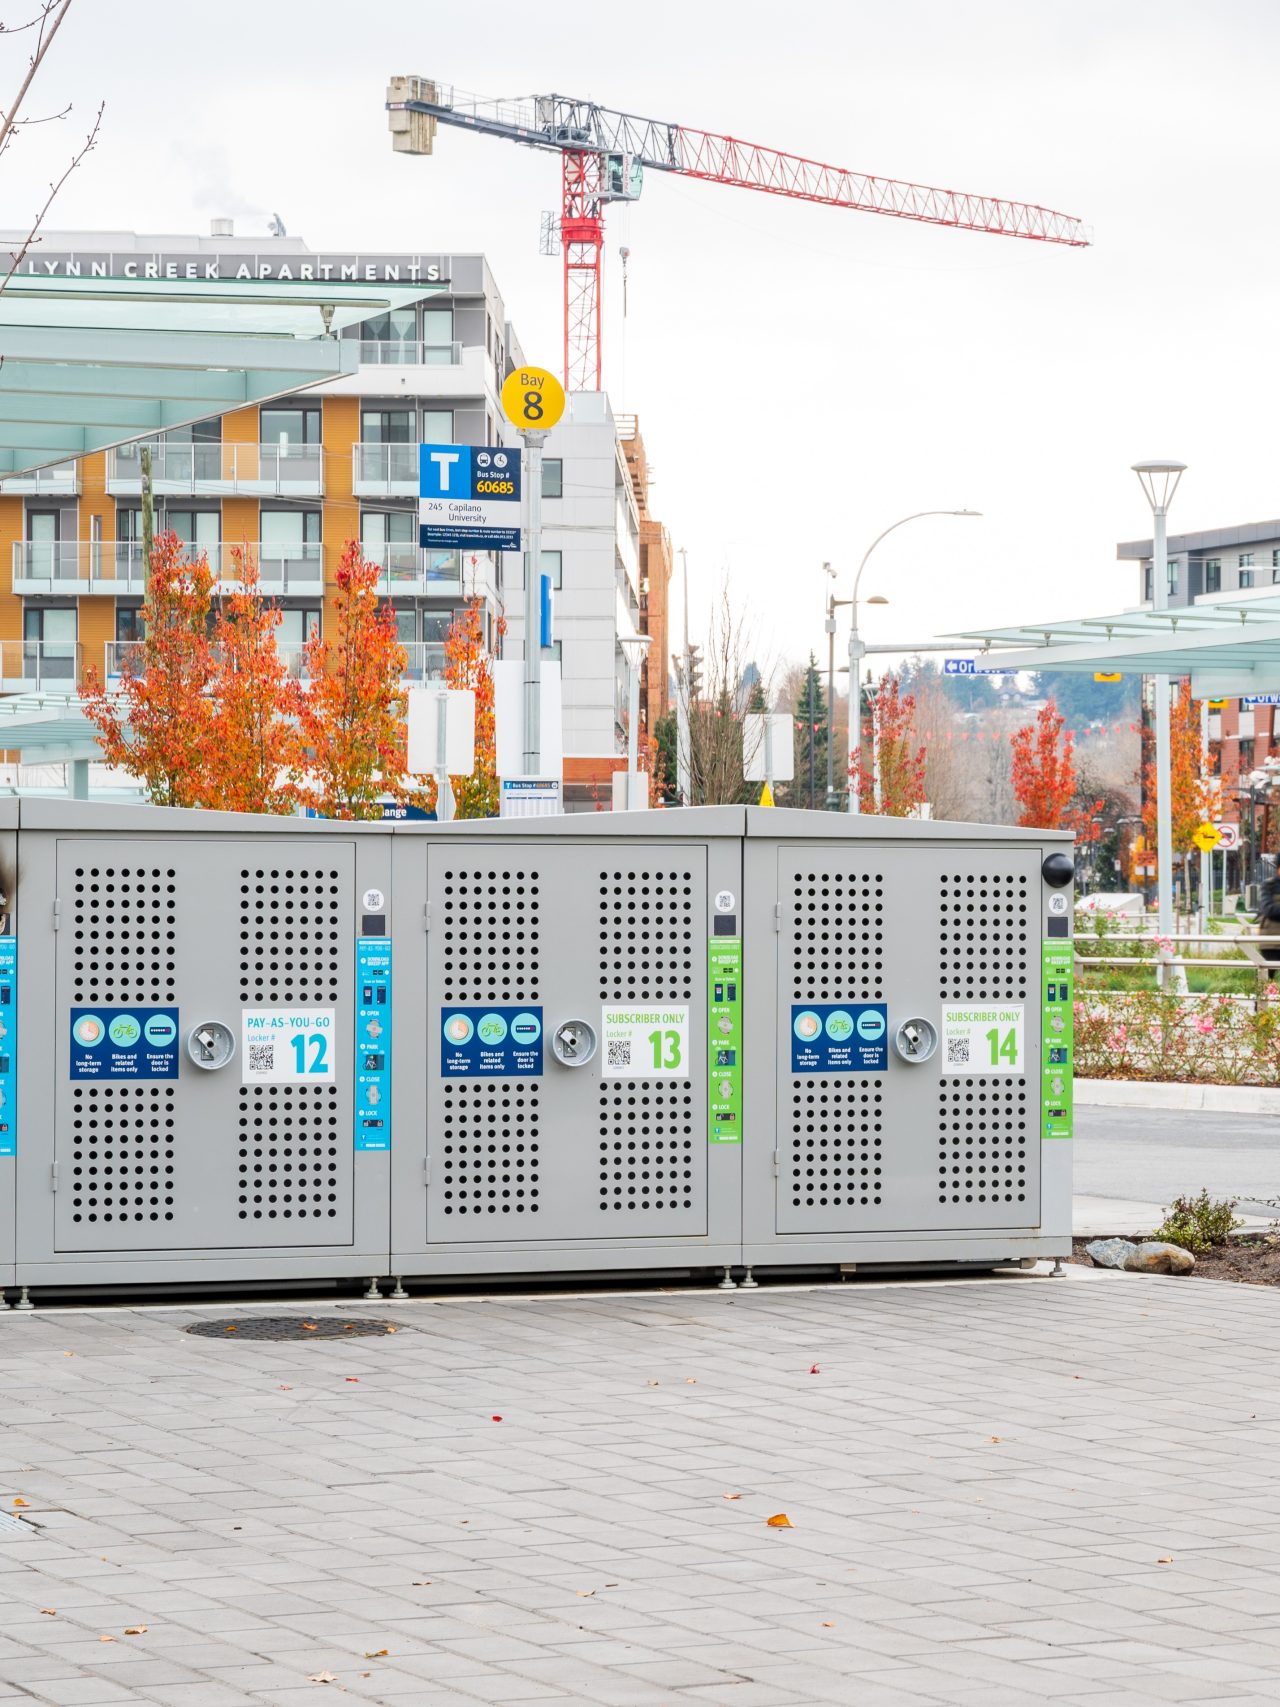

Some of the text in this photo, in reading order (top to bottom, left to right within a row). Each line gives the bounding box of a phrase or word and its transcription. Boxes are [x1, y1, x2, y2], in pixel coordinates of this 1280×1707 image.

[29, 261, 439, 281] LYNN CREEK APARTMENTS
[521, 373, 545, 390] Bay
[523, 391, 543, 420] 8
[430, 452, 459, 491] T
[490, 471, 505, 479] Stop
[476, 480, 514, 494] 60685
[428, 502, 482, 513] 245 Capilano
[448, 513, 487, 524] University
[247, 1017, 330, 1028] PAY-AS-YOU-GO
[606, 1013, 684, 1023] SUBSCRIBER ONLY
[946, 1012, 1020, 1022] SUBSCRIBER ONLY
[606, 1029, 627, 1037] Locker
[946, 1027, 966, 1035] Locker
[247, 1033, 269, 1041] Locker
[648, 1030, 681, 1069] 13
[985, 1028, 1018, 1066] 14
[290, 1034, 328, 1073] 12
